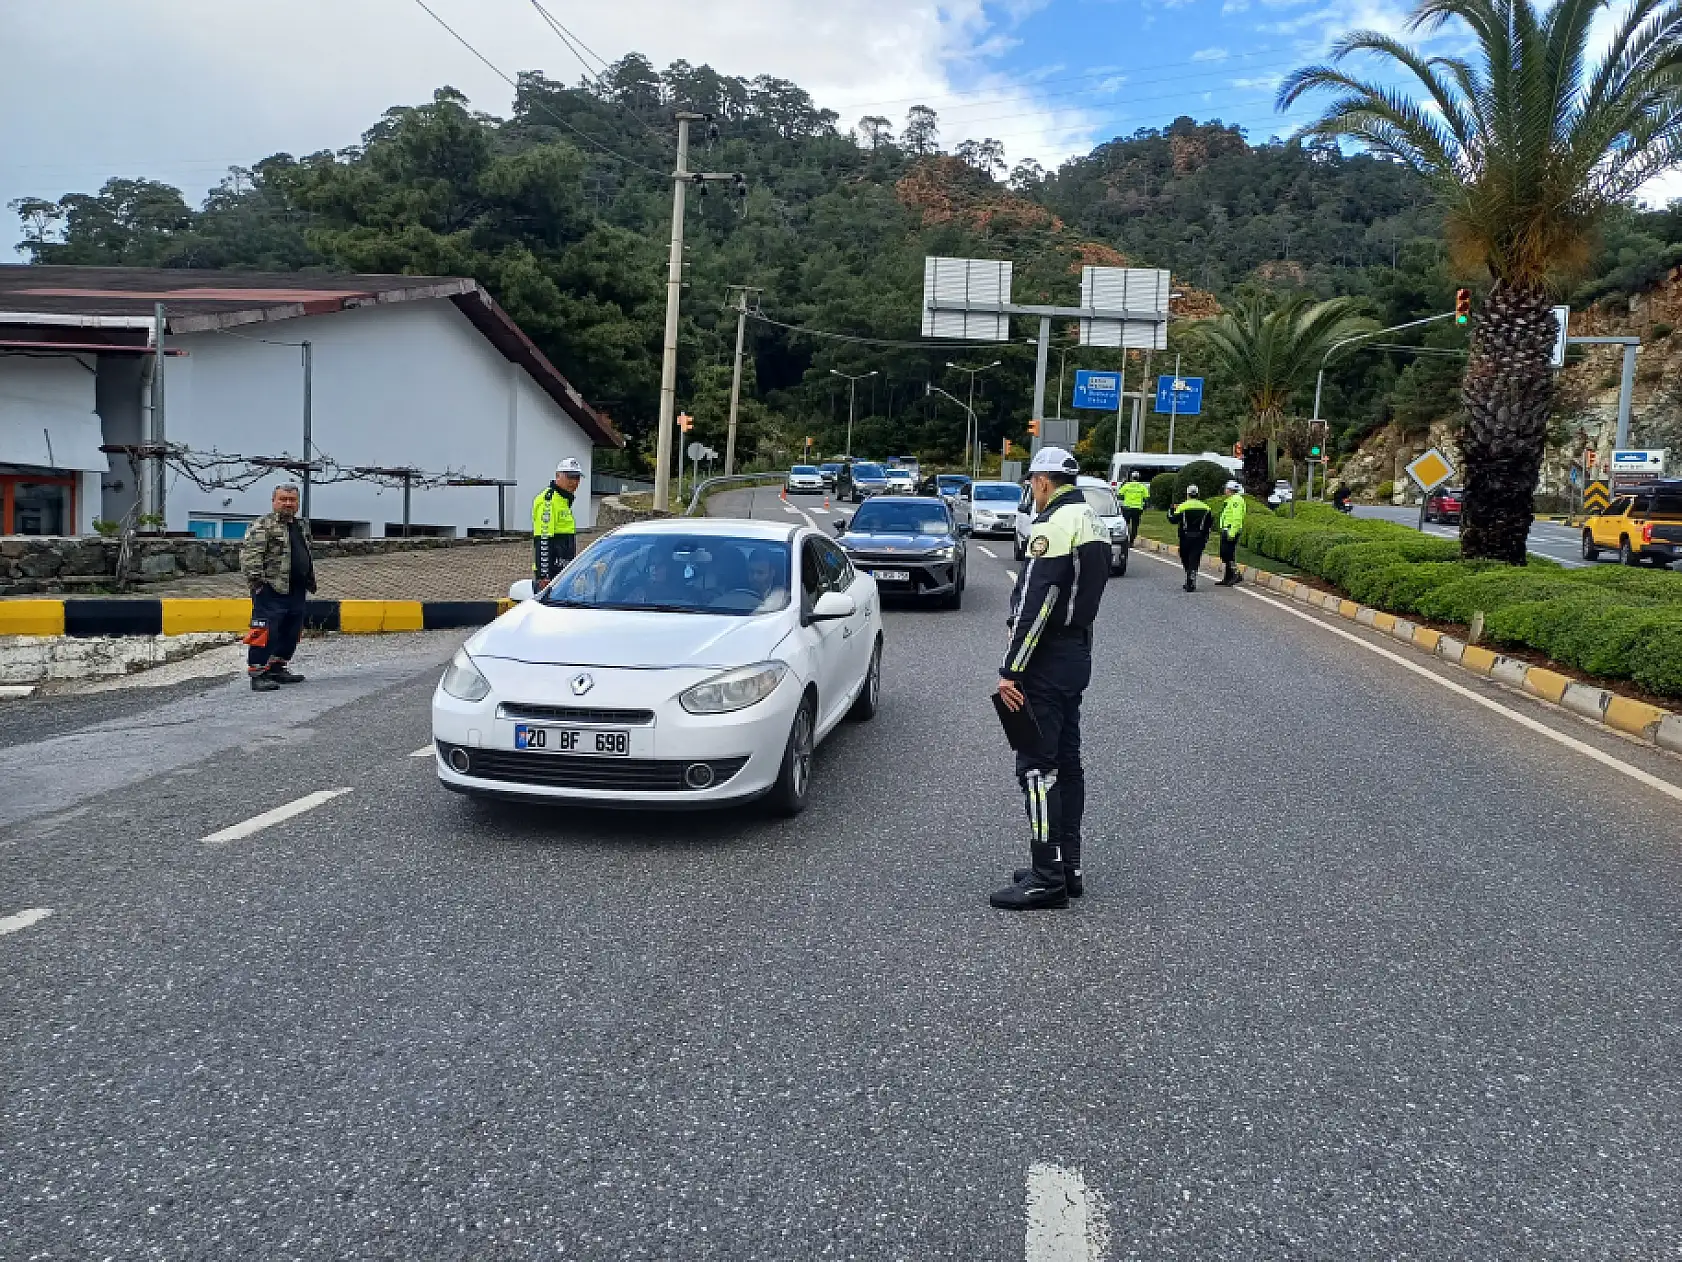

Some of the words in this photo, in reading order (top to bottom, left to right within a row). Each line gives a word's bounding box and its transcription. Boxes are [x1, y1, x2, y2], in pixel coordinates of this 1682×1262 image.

[527, 730, 545, 747] 20
[560, 732, 580, 749] BF
[595, 734, 625, 752] 698
